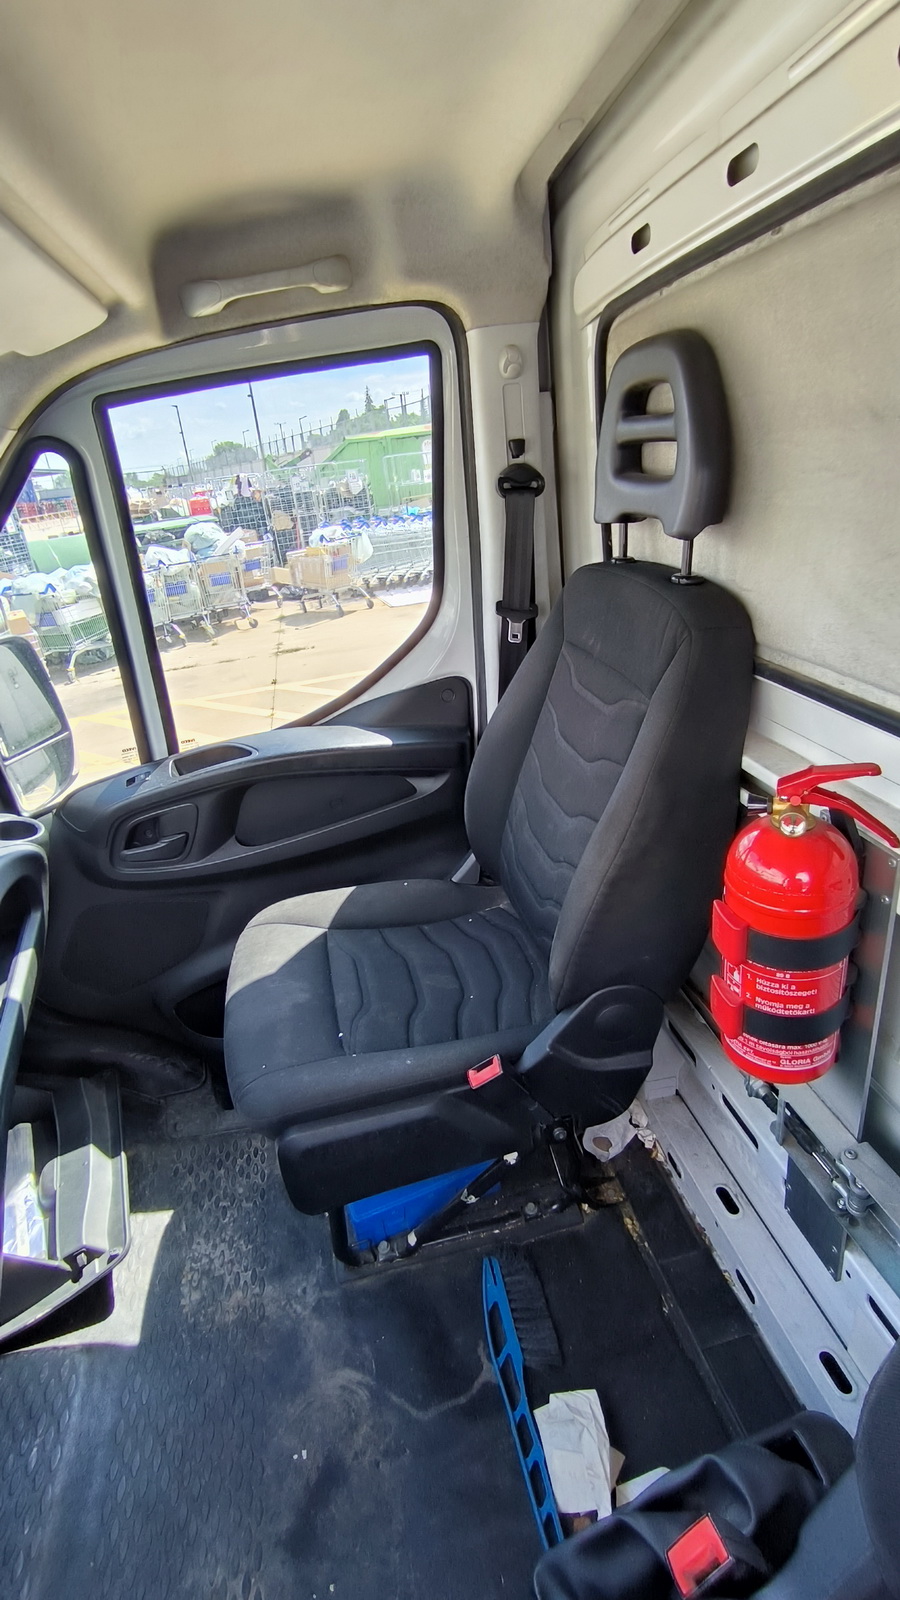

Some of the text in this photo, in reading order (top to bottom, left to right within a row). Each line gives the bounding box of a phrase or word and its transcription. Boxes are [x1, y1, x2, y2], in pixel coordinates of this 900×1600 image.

[756, 977, 780, 989] Húzza
[781, 982, 789, 990] ki
[755, 996, 784, 1009] Nyomja
[786, 1003, 804, 1011] meg
